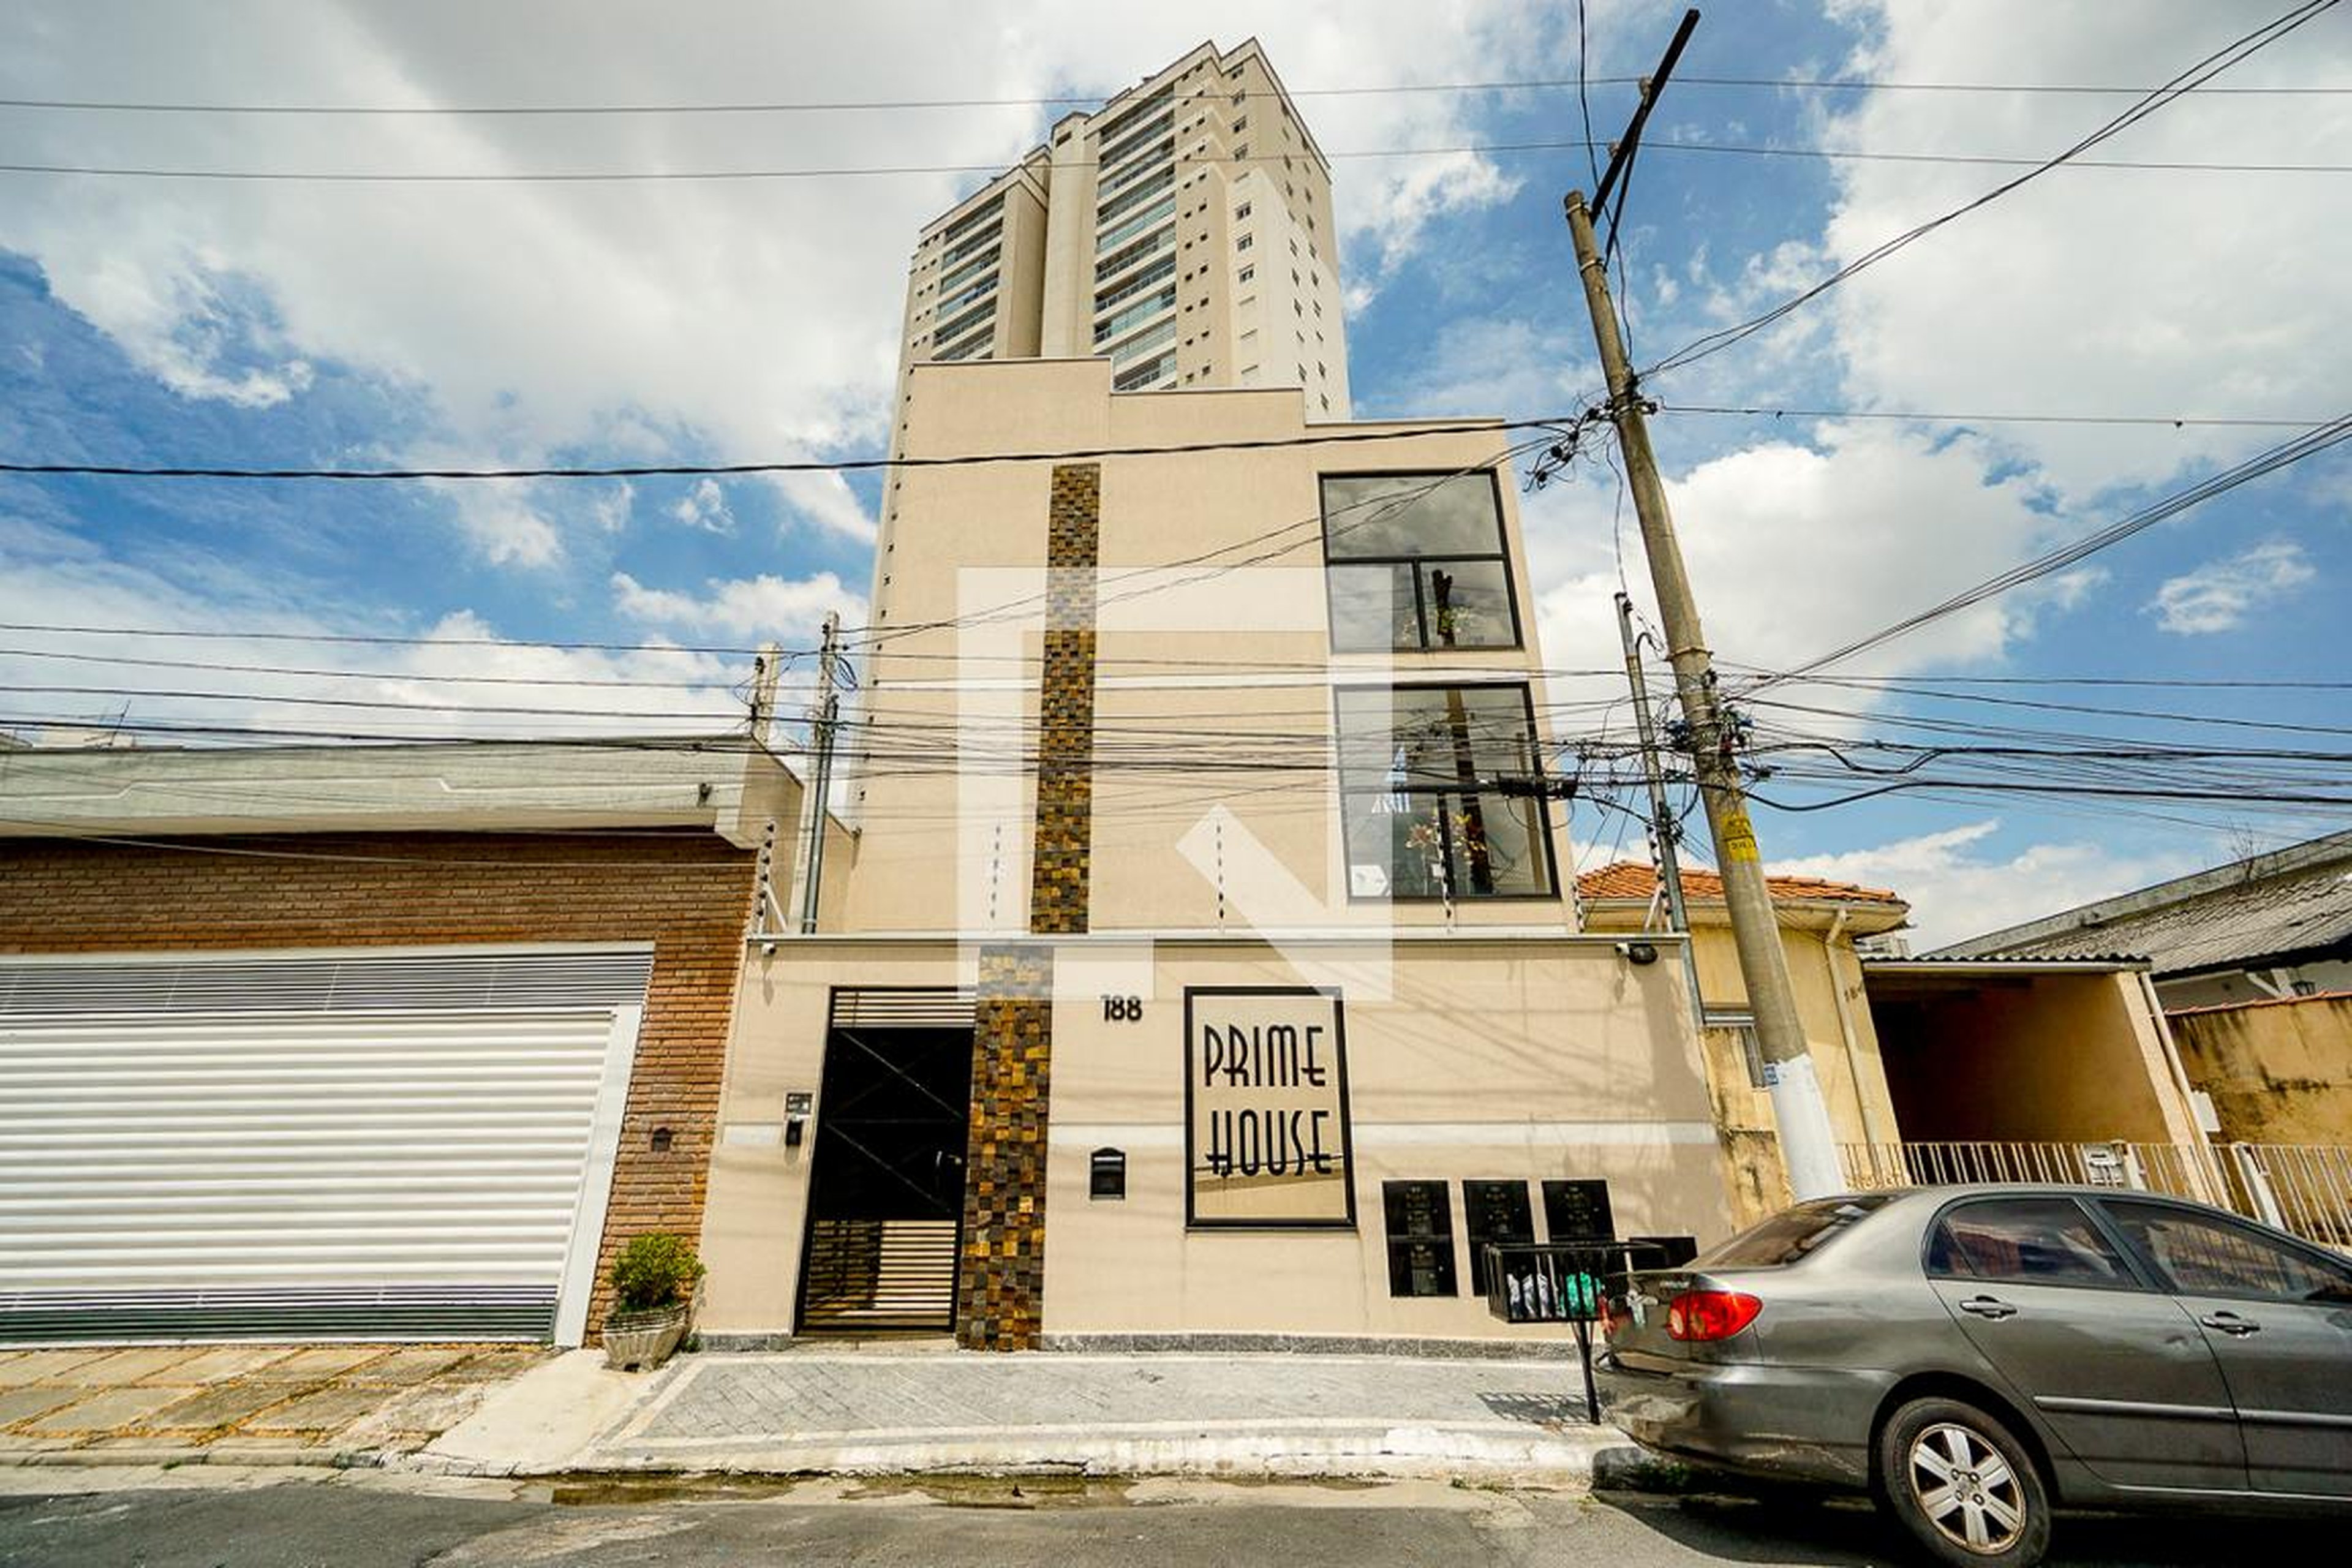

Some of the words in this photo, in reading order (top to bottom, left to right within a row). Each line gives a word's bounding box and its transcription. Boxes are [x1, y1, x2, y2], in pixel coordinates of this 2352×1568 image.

[1101, 995, 1142, 1022] 188
[1204, 1025, 1326, 1087] PRIME
[1205, 1110, 1332, 1177] HOUSE
